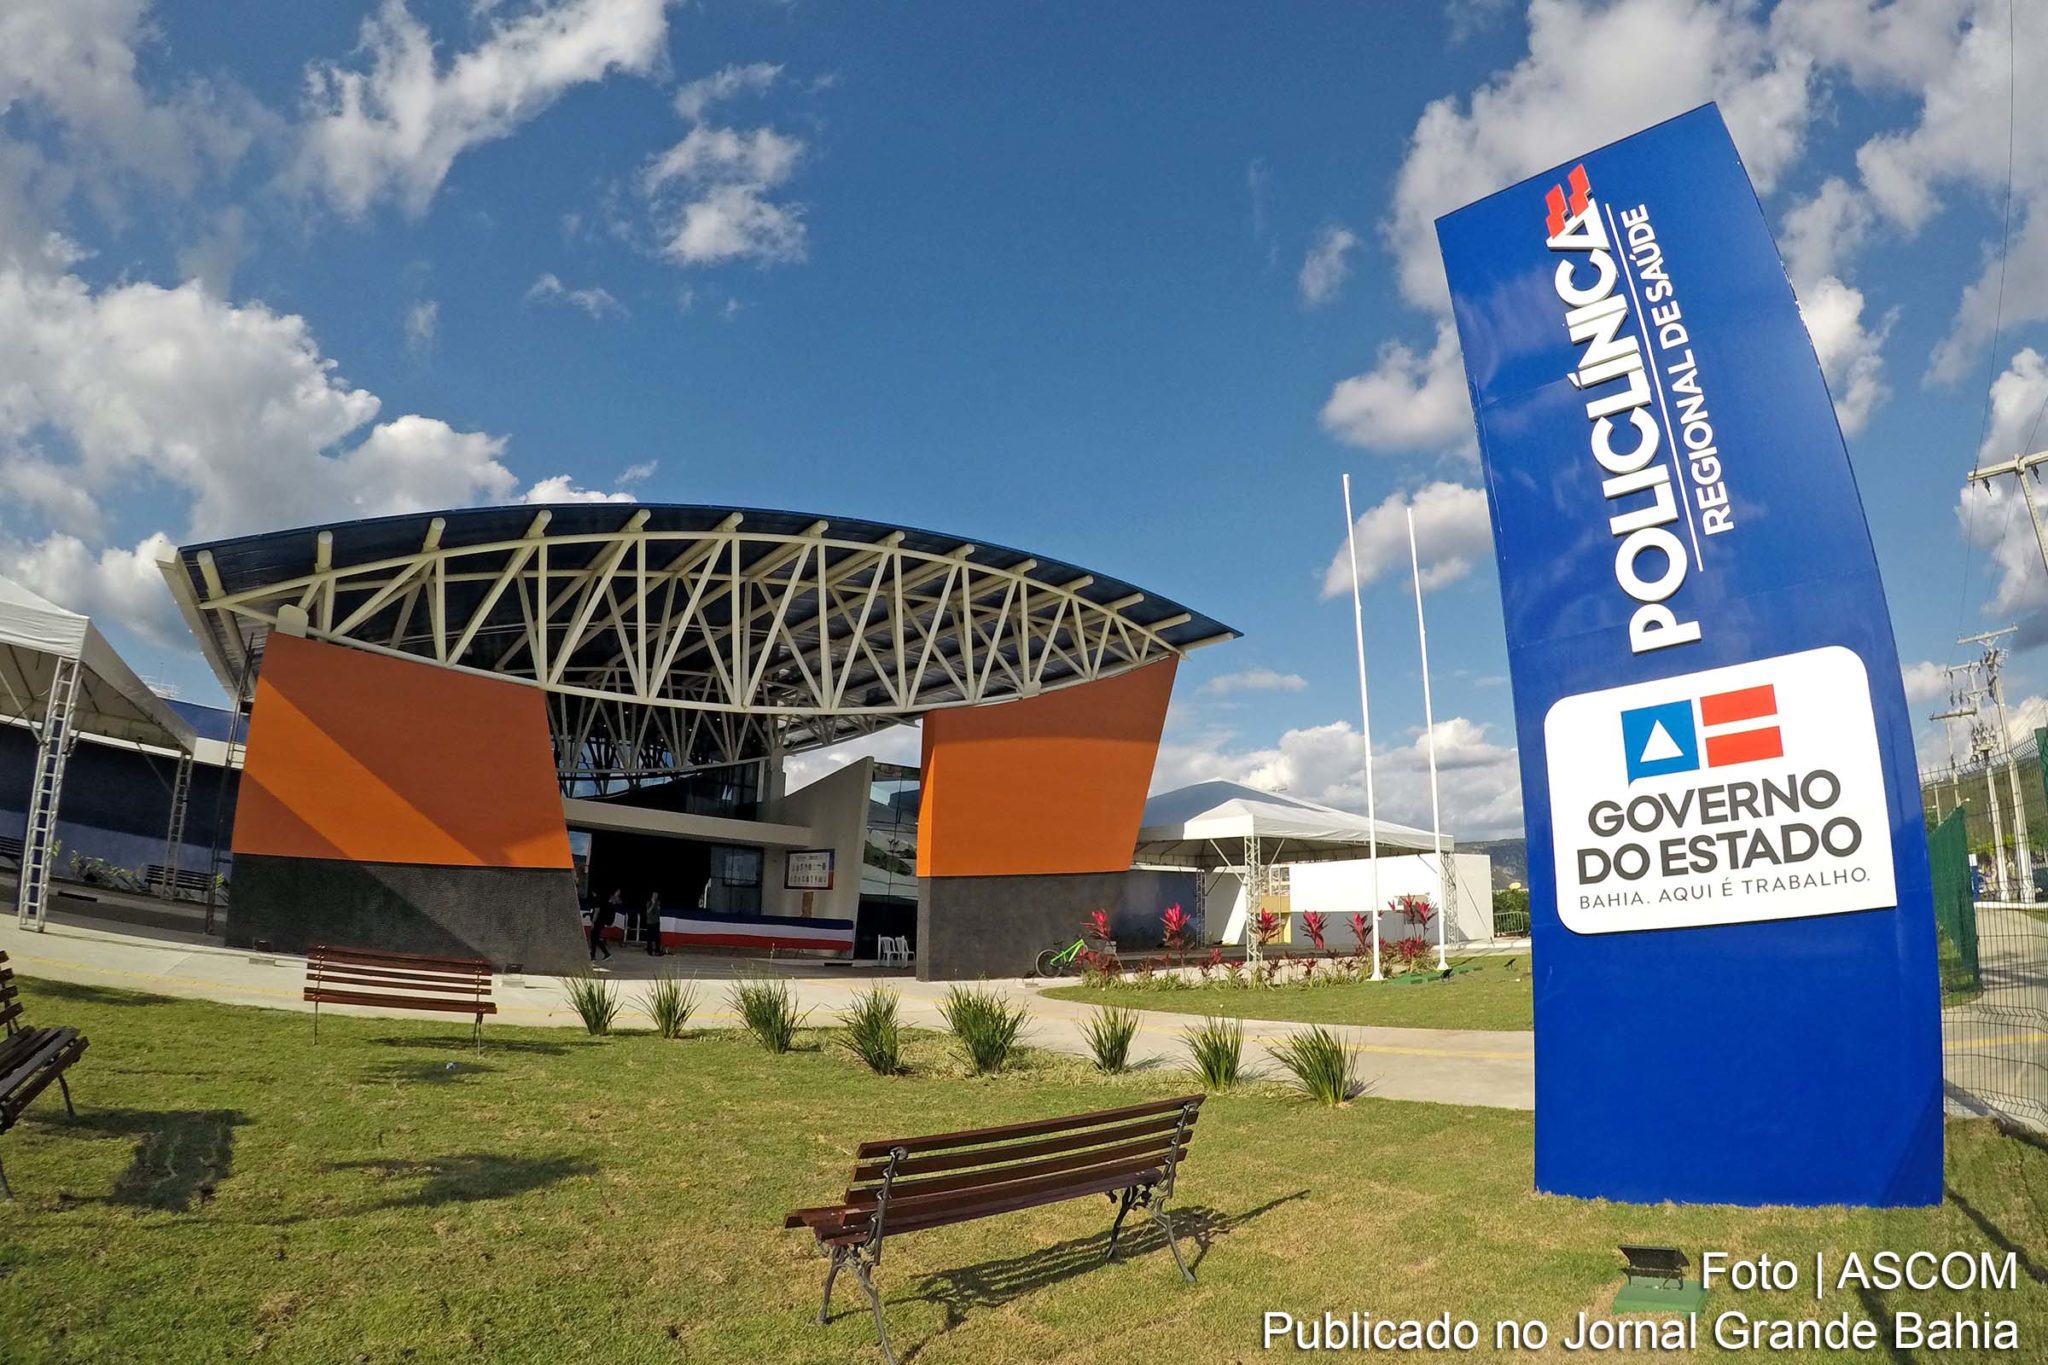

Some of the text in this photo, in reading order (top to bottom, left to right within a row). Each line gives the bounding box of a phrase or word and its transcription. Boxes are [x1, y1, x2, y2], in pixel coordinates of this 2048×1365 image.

[1620, 203, 1735, 536] REGIONAL DE SAÚDE
[1545, 197, 1702, 653] POLICLÍNICA
[1587, 769, 1841, 838] GOVERNO
[1576, 816, 1863, 885] DO ESTADO
[1579, 867, 1870, 909] BAHIA. AQUI É TRABALHO.
